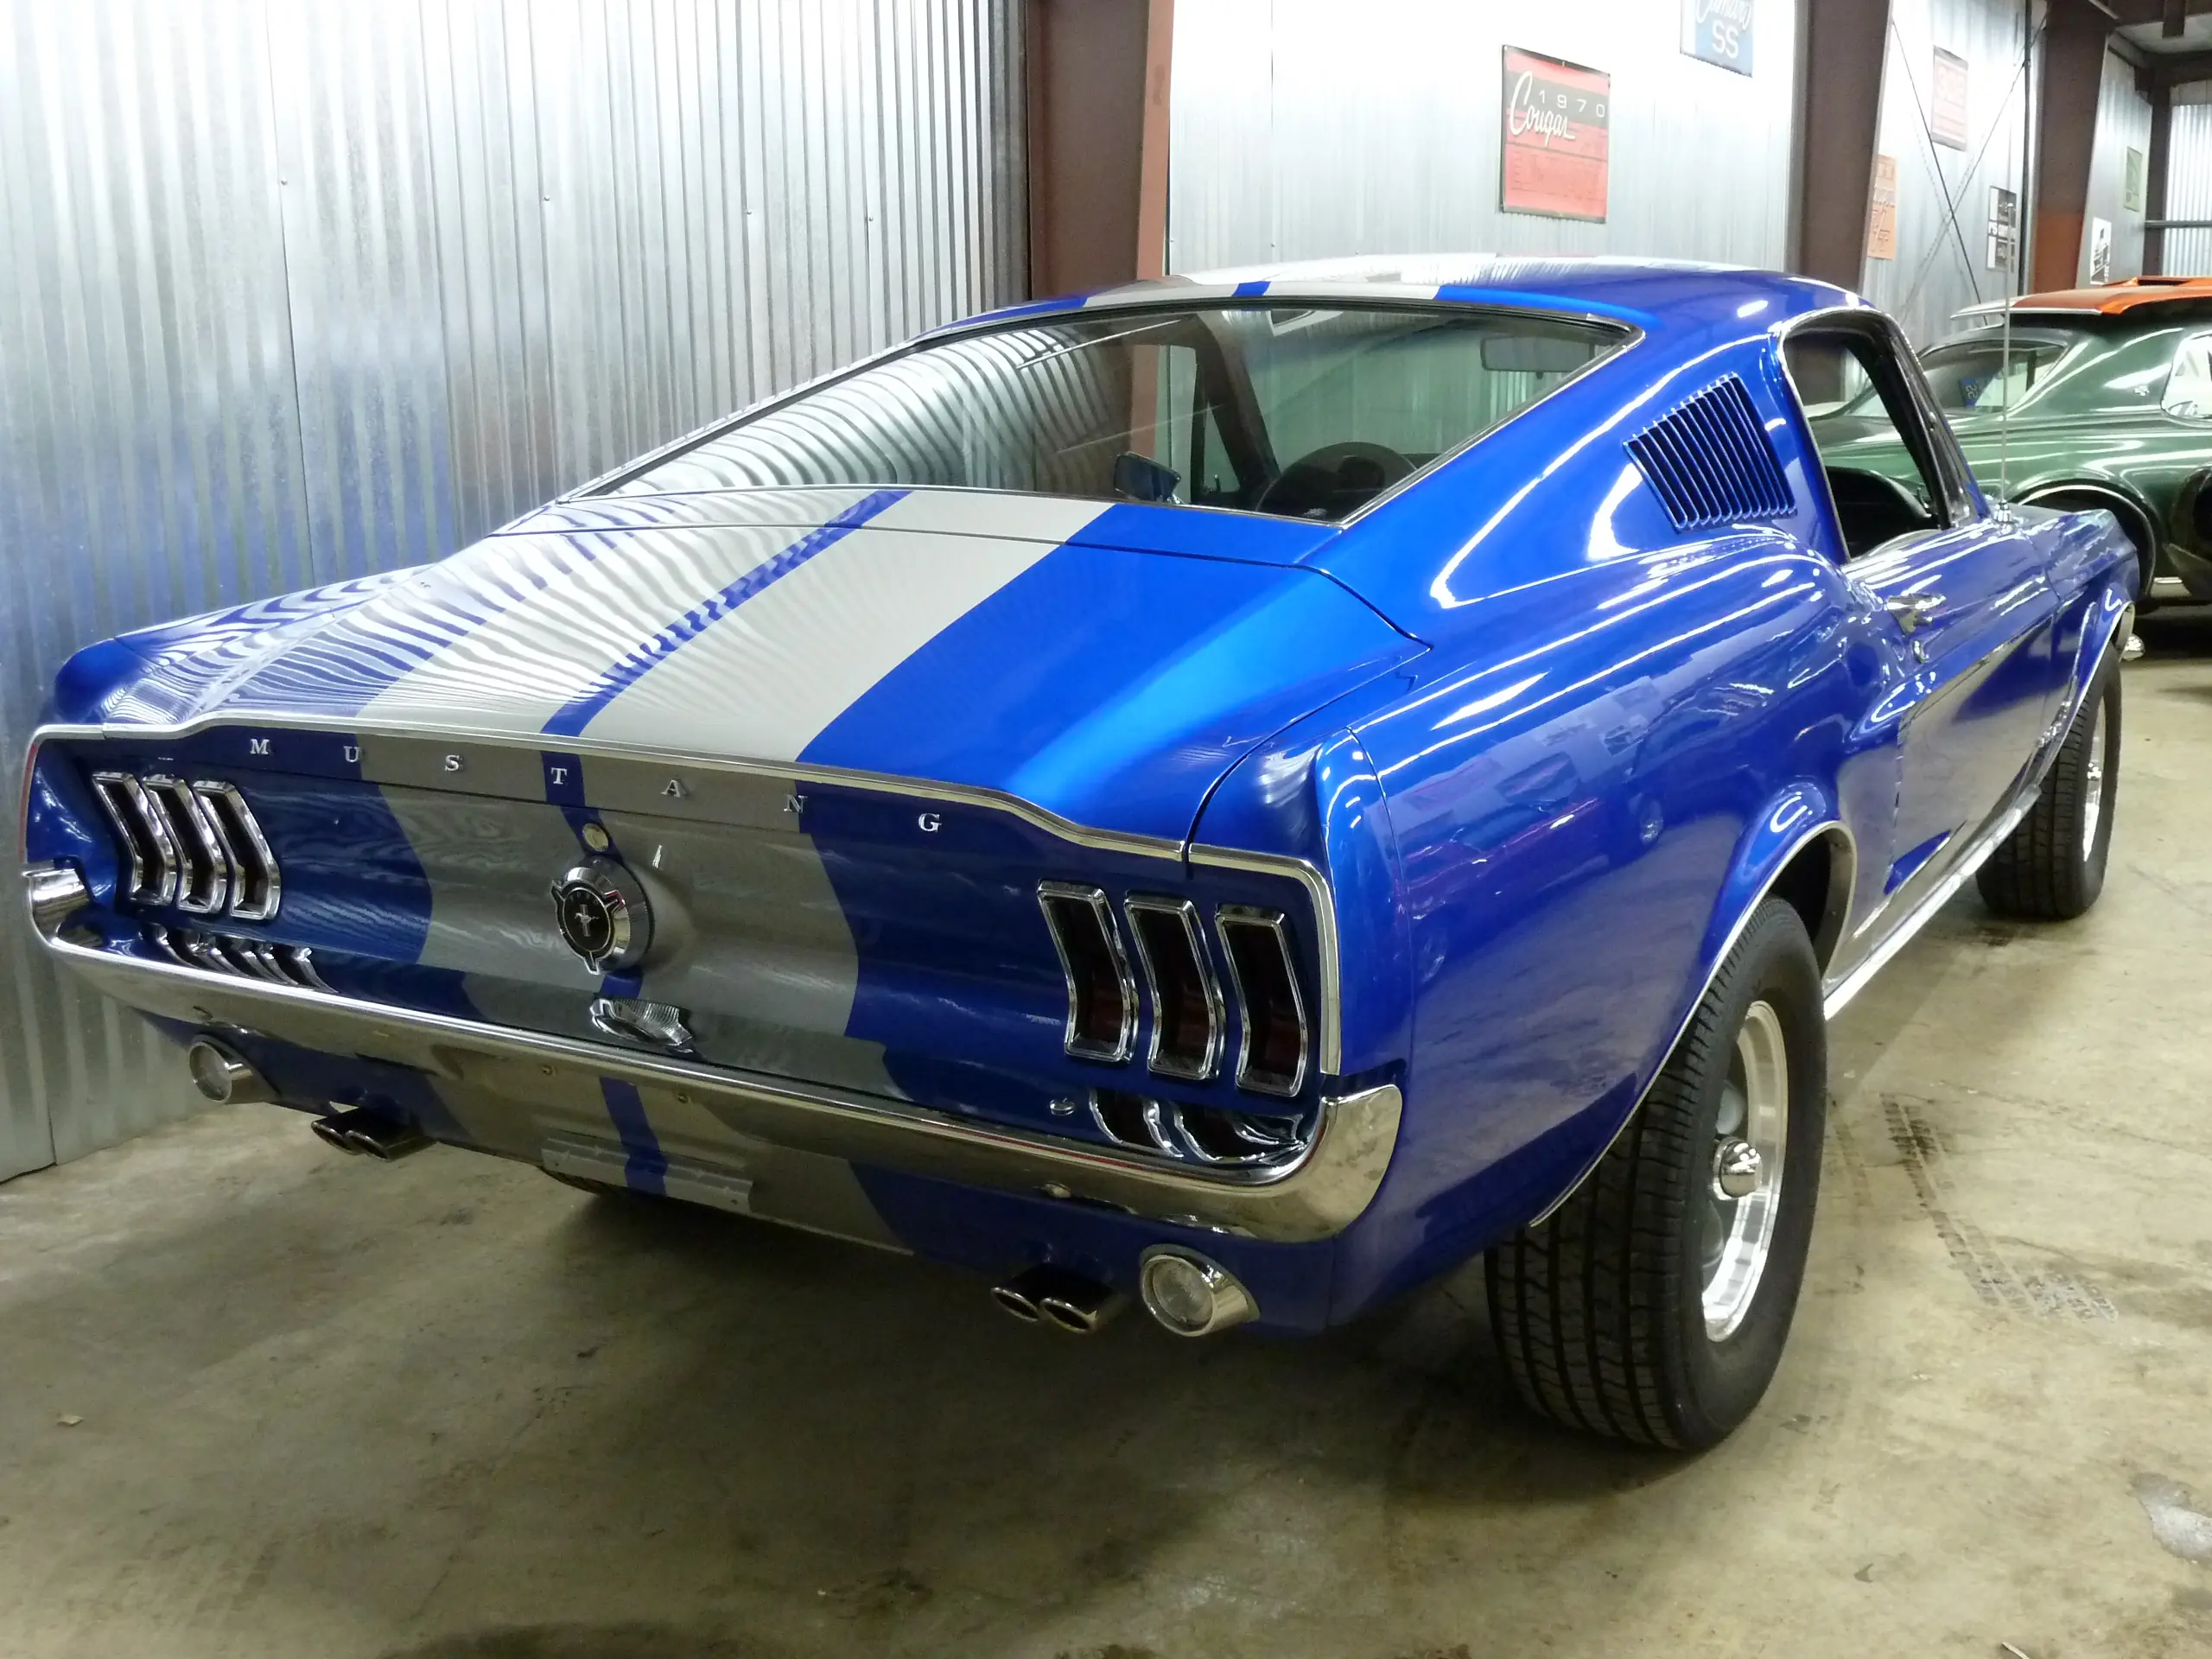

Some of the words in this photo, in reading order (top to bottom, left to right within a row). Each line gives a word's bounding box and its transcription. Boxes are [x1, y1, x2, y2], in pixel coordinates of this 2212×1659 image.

[1712, 19, 1738, 59] SS
[1510, 70, 1576, 148] Cougar
[1539, 89, 1605, 118] 1970
